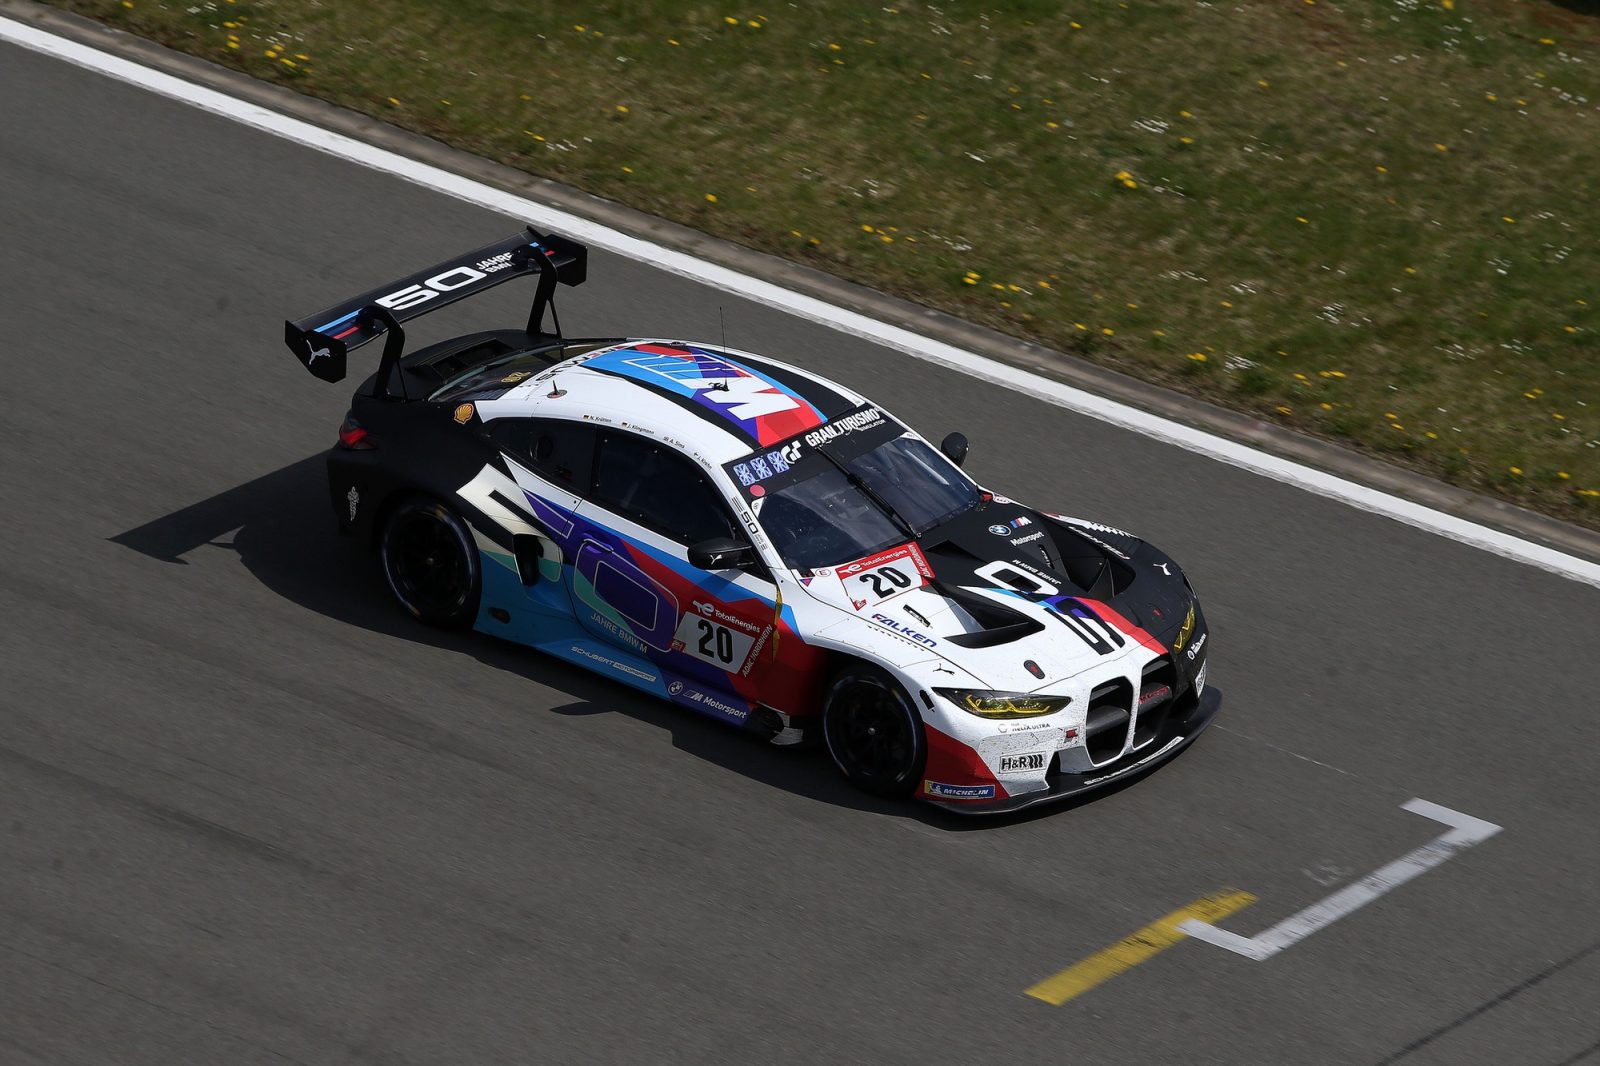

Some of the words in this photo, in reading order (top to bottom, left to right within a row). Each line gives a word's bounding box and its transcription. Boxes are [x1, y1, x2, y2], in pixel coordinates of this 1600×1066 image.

[476, 251, 514, 270] JAHRE
[374, 265, 488, 311] 50
[741, 511, 759, 535] 50
[1010, 530, 1045, 547] Motorsport
[859, 566, 912, 599] 20
[714, 609, 761, 633] TotalEnergies
[871, 613, 937, 648] FALKEN
[591, 613, 618, 635] JAHRE
[618, 630, 640, 648] BMW
[639, 643, 649, 653] M
[698, 619, 734, 664] 20
[571, 646, 614, 666] SCHUBERT
[741, 657, 755, 678] ADAC
[703, 696, 747, 719] Motorsport
[1001, 756, 1028, 771] H&R
[943, 787, 989, 797] MICHELIN
